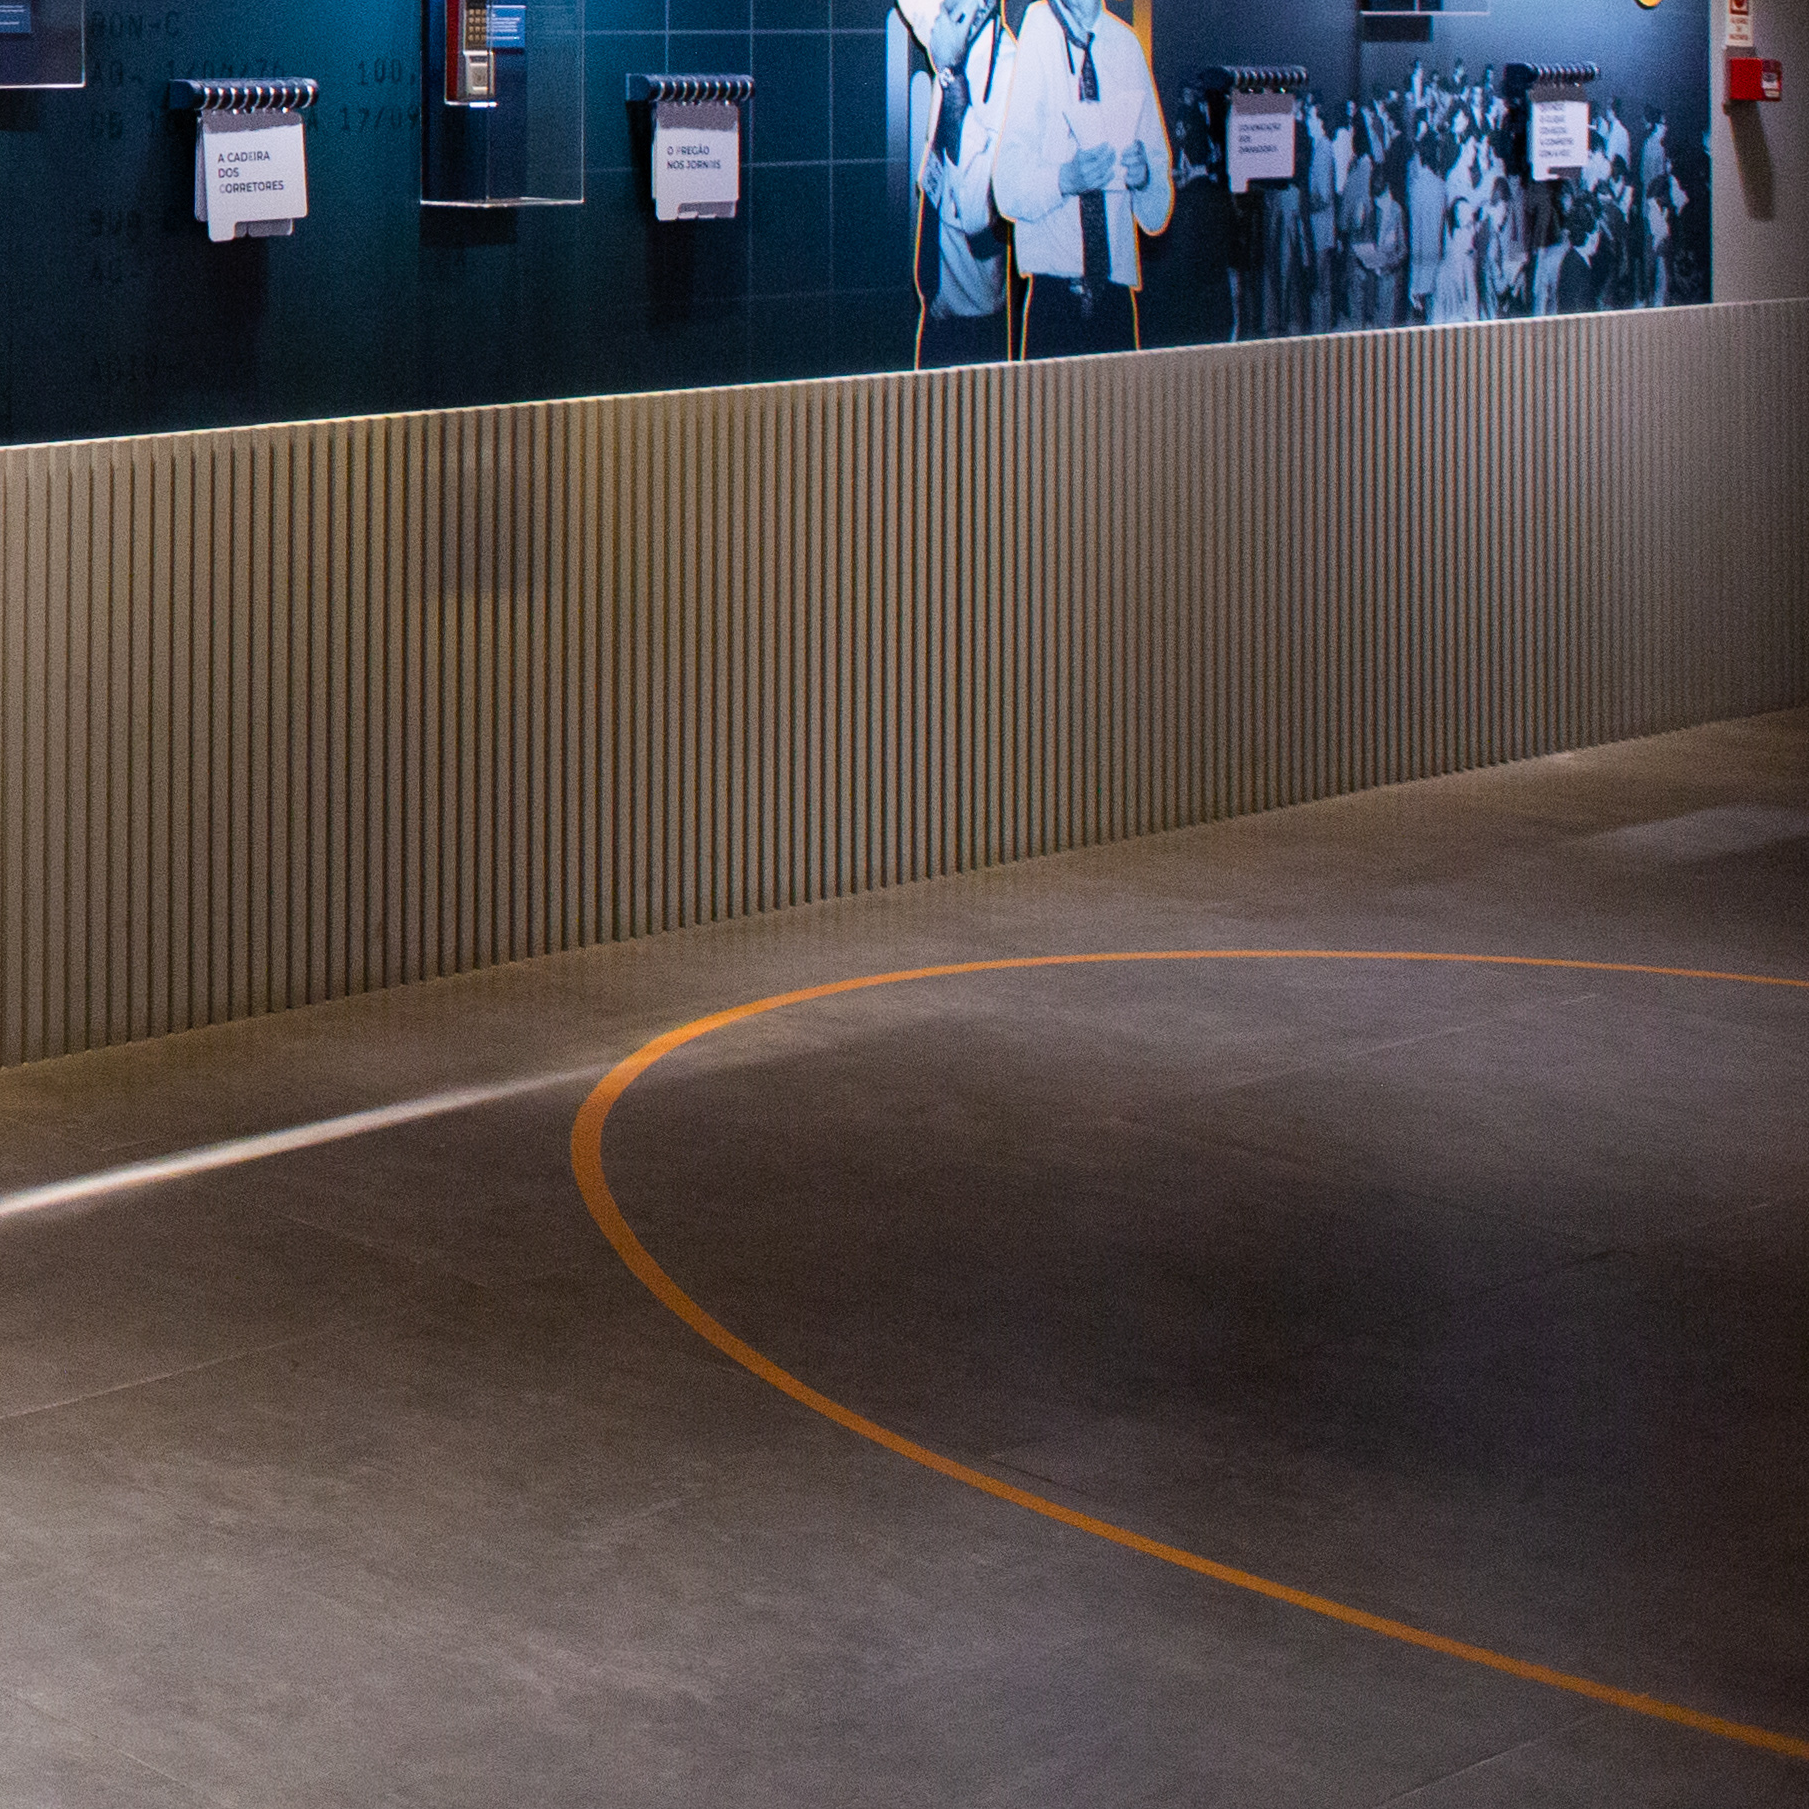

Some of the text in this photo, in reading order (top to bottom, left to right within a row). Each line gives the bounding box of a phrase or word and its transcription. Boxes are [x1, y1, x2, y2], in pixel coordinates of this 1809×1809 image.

[217, 151, 271, 163] A CADEIRA
[218, 167, 240, 179] DOS
[219, 180, 285, 194] CORRETORES
